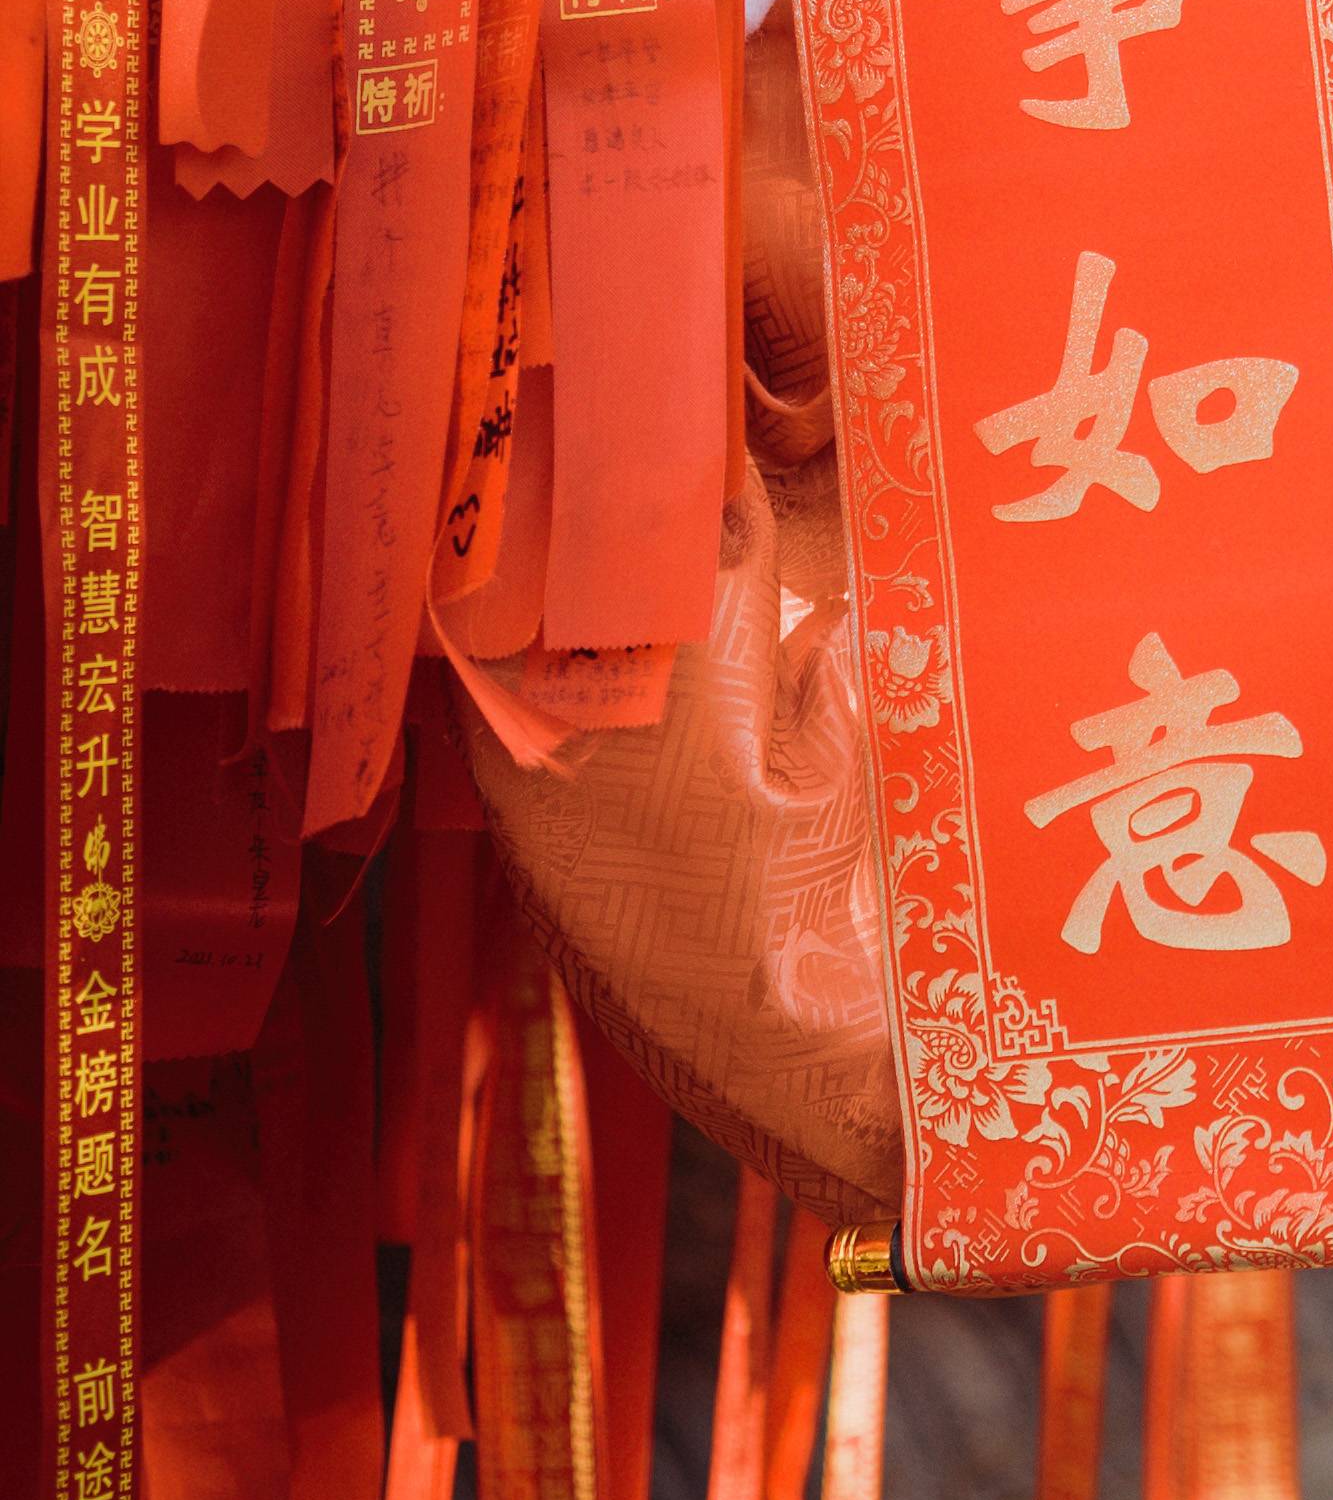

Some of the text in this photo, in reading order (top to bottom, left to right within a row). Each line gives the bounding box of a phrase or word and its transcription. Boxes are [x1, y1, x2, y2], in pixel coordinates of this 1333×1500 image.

[73, 102, 124, 798] 学业有成 智慧宏升
[72, 965, 119, 1278] 金榜题名
